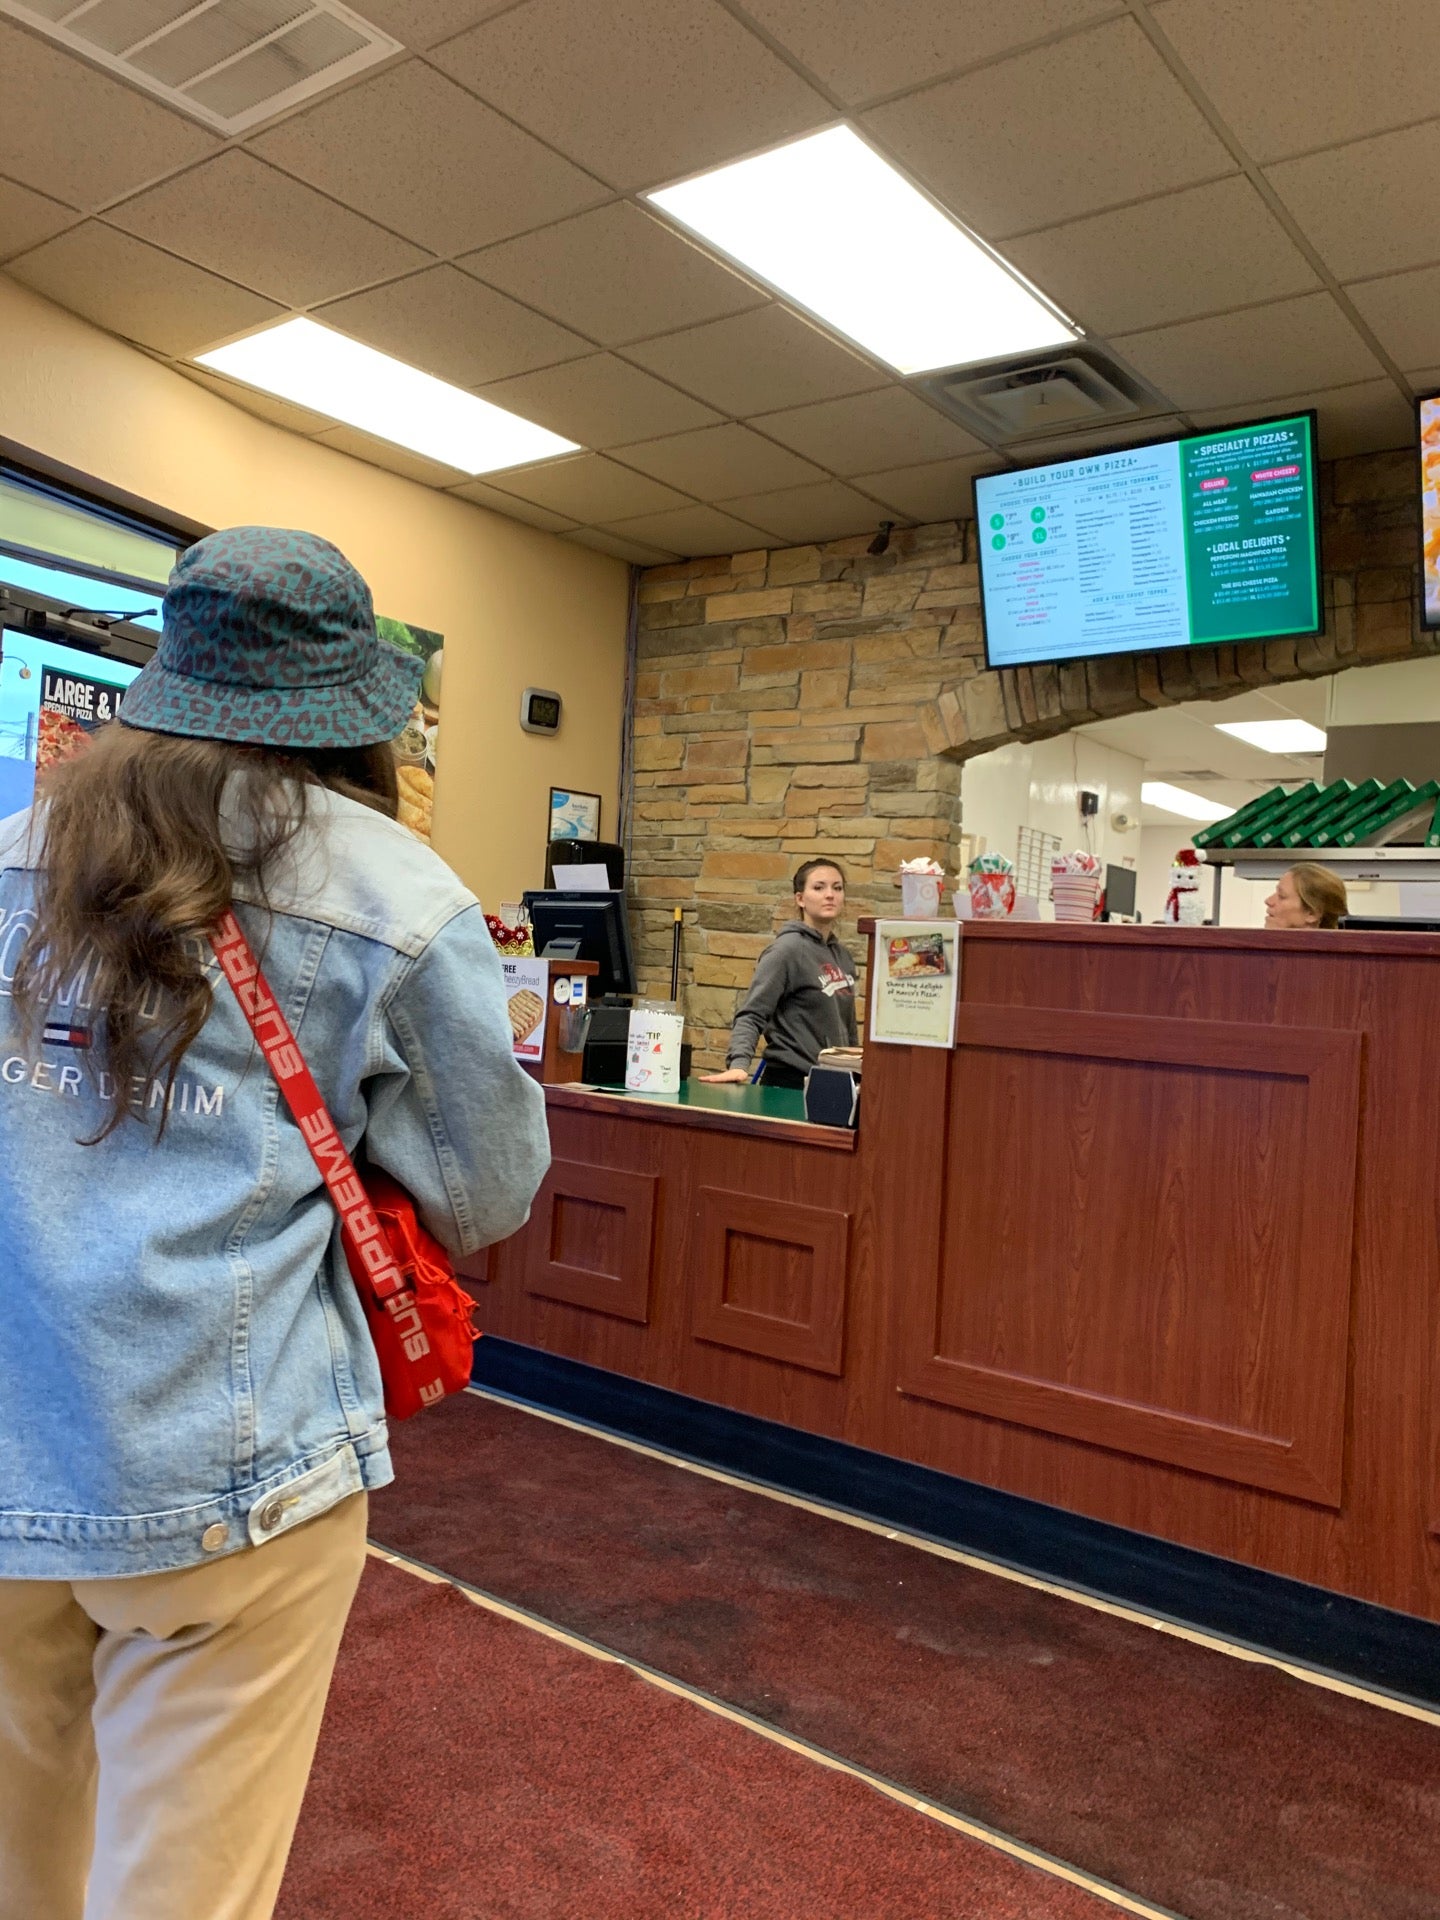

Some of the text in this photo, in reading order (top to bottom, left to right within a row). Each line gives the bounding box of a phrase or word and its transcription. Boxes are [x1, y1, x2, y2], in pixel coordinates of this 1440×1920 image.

[1200, 438, 1250, 456] SPECIALTY
[1253, 431, 1288, 446] PIZZAS
[1018, 459, 1133, 487] BUILD YOUR OWN PIZZA
[1212, 534, 1284, 553] LOCAL DELIGHTS
[45, 675, 94, 710] LARGE
[97, 692, 111, 720] &
[44, 701, 93, 721] SPECIALTY PIZZA
[504, 974, 540, 987] heezyBread
[212, 912, 304, 1081] SUPRE
[646, 1032, 661, 1040] TIP
[2, 1057, 82, 1096] GER
[300, 1106, 405, 1290] UPREME
